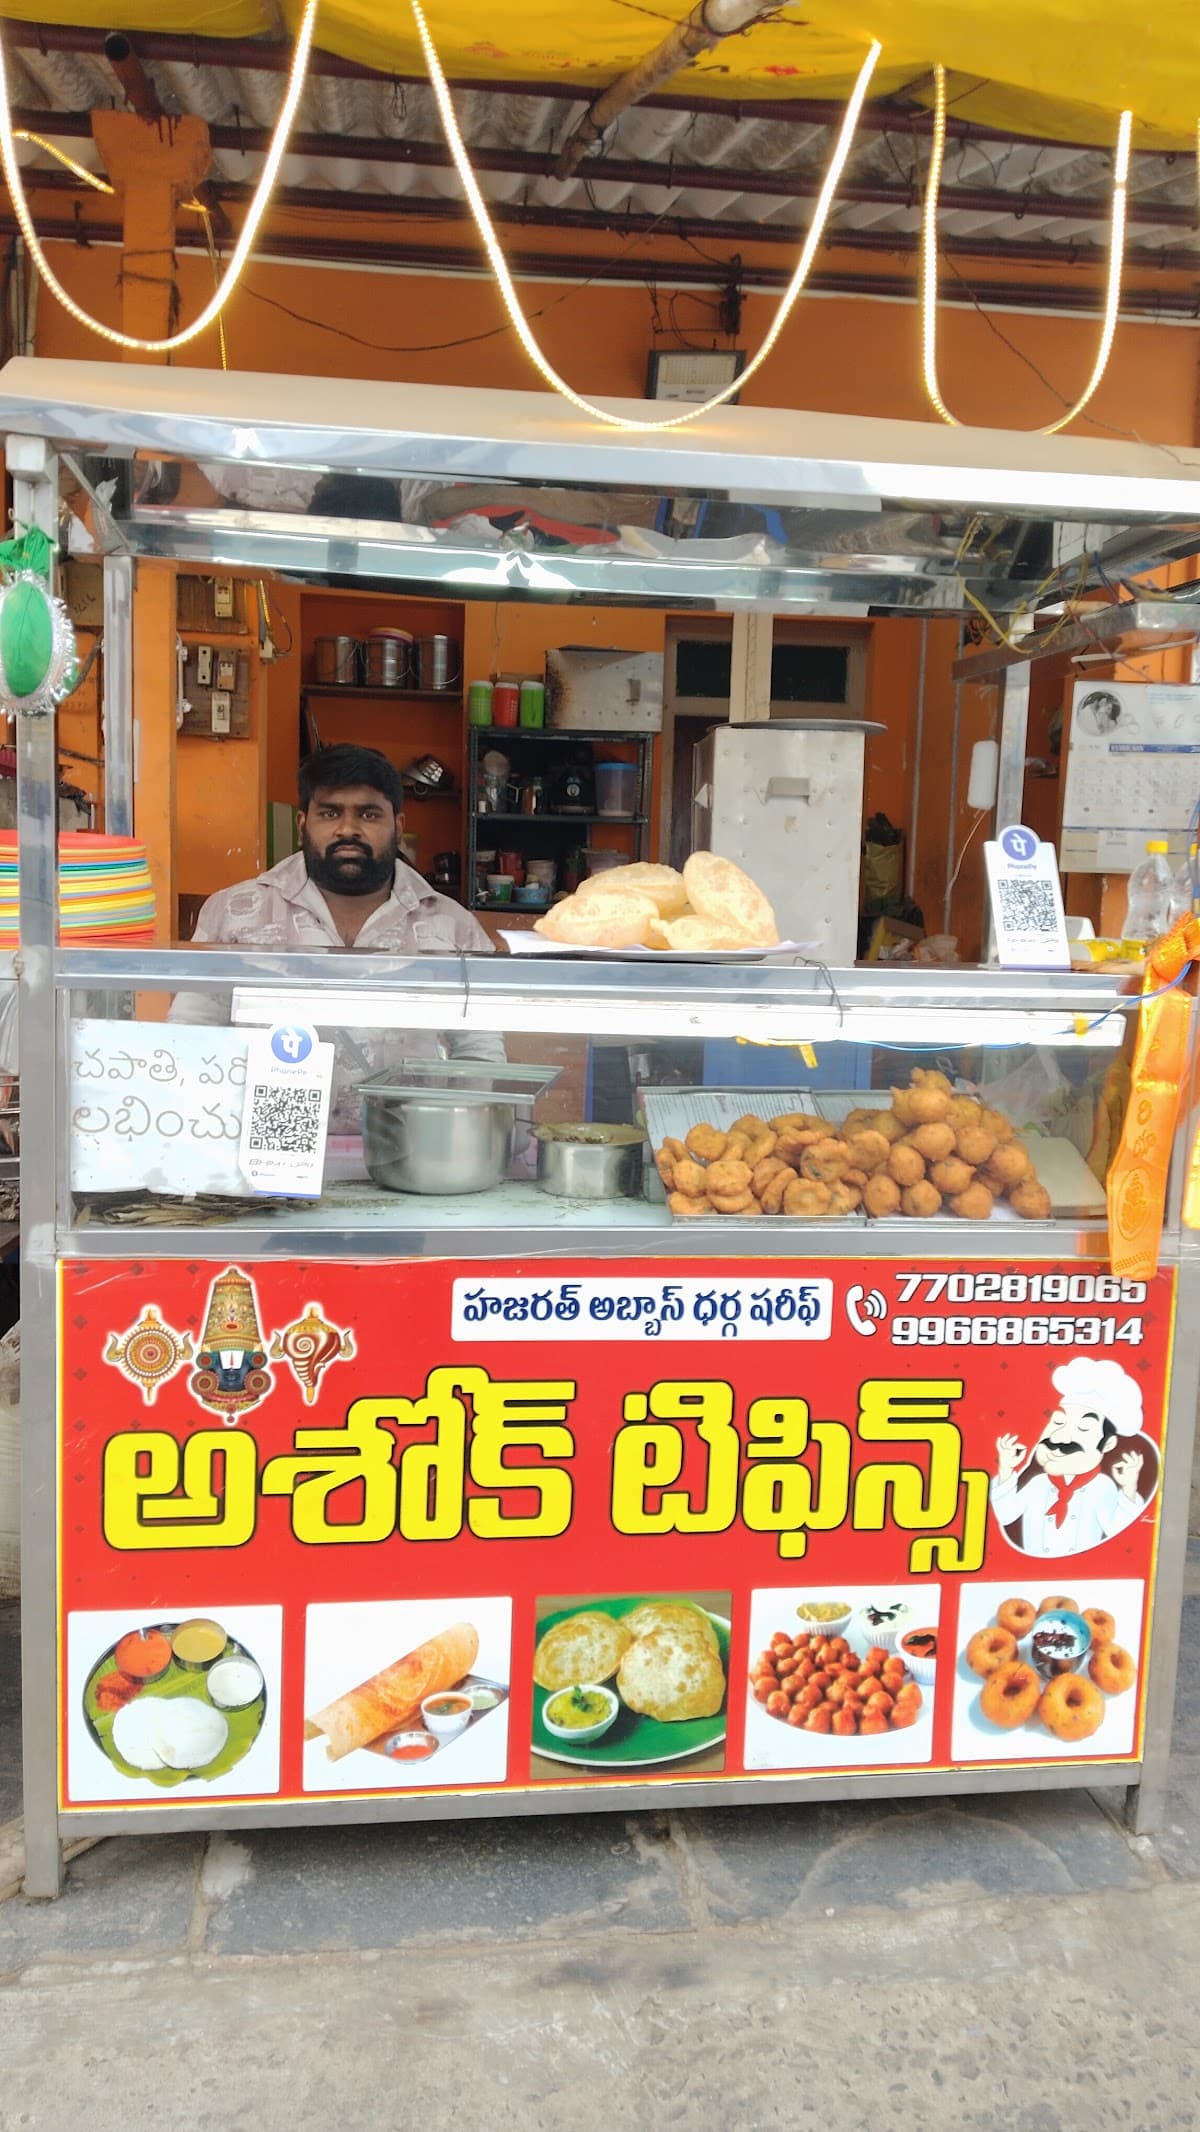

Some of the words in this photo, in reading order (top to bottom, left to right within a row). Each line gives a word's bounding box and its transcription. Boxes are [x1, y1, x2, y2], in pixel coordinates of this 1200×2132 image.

[895, 1273, 1147, 1303] 7702819065
[463, 1284, 582, 1321] హజరత్
[589, 1285, 685, 1336] అబ్బాస్
[693, 1289, 742, 1337] ధర్గ
[750, 1286, 820, 1327] షరీఫ్
[891, 1316, 1144, 1346] 9966865314
[103, 1365, 576, 1551] అశోక్
[611, 1378, 989, 1574] టిఫిన్స్
